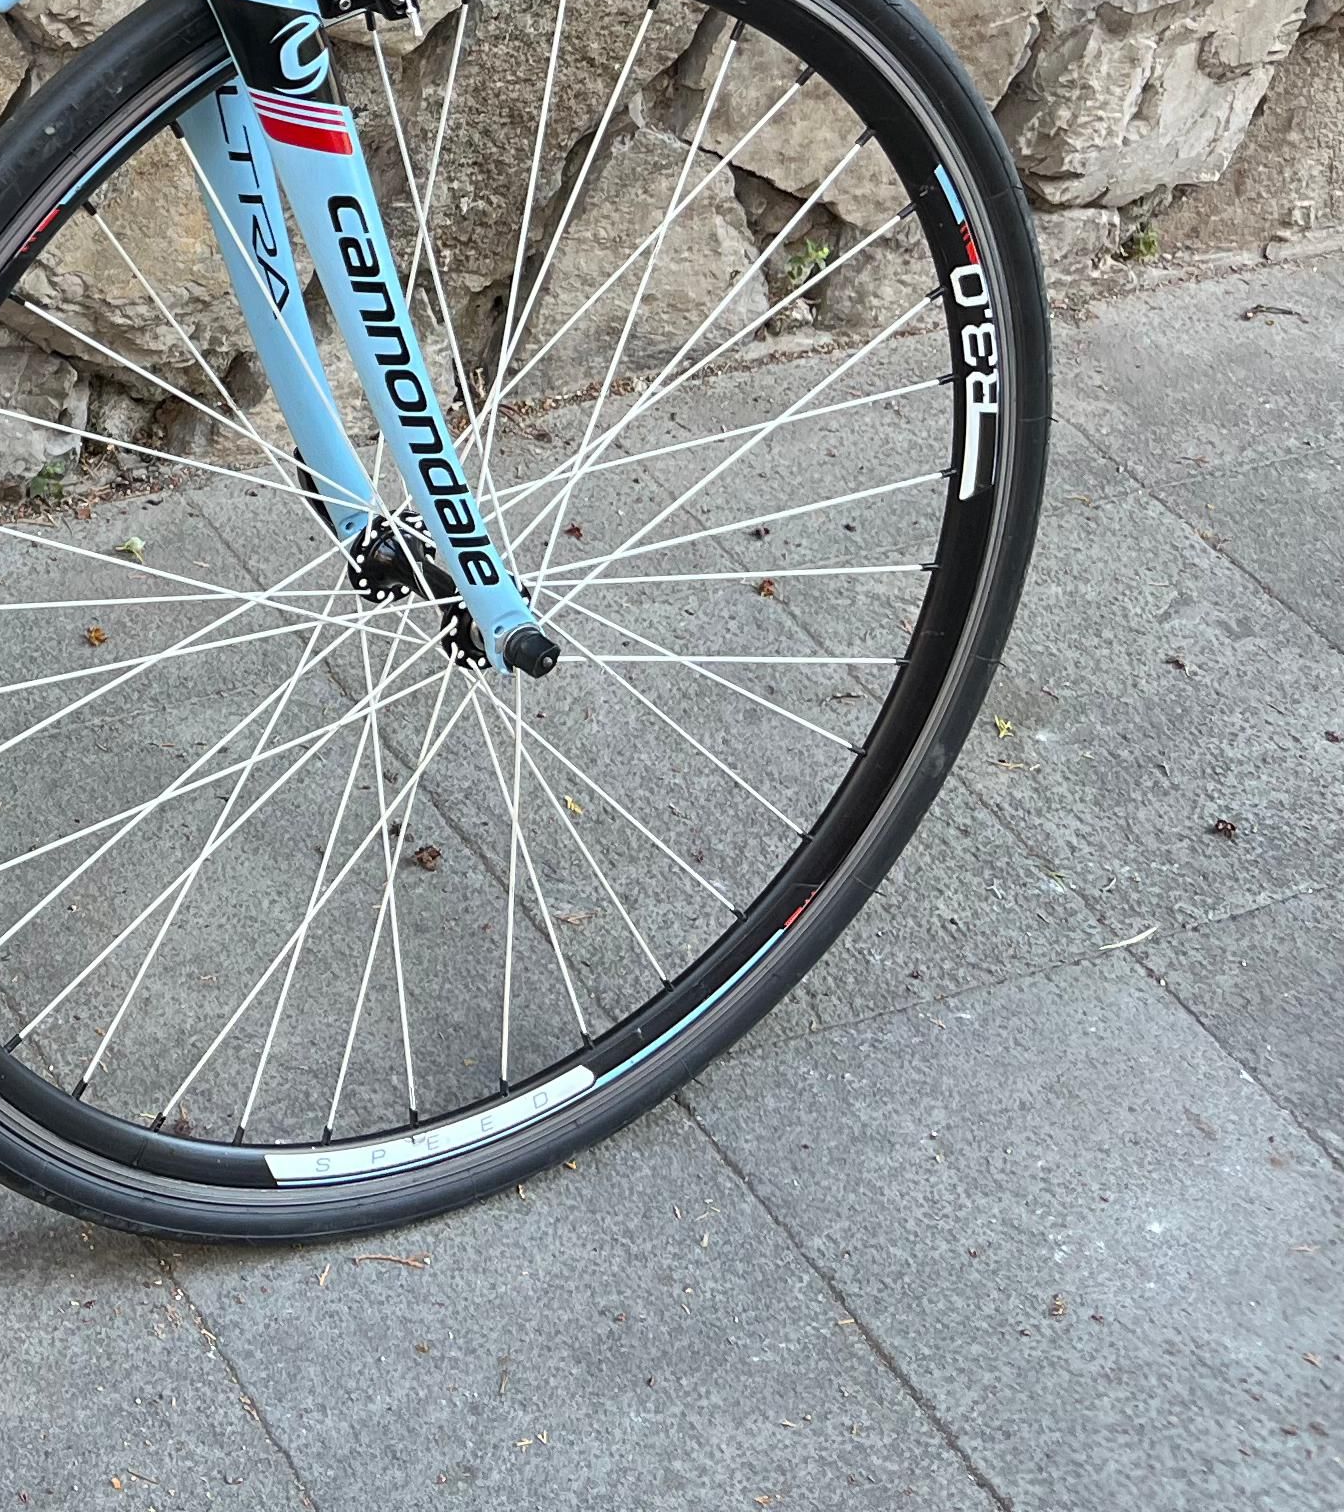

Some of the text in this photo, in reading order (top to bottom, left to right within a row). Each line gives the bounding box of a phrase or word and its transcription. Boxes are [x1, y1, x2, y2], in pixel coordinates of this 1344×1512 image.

[327, 194, 500, 587] cannondale
[949, 263, 1000, 414] R3.0
[315, 1091, 550, 1175] SPEED
